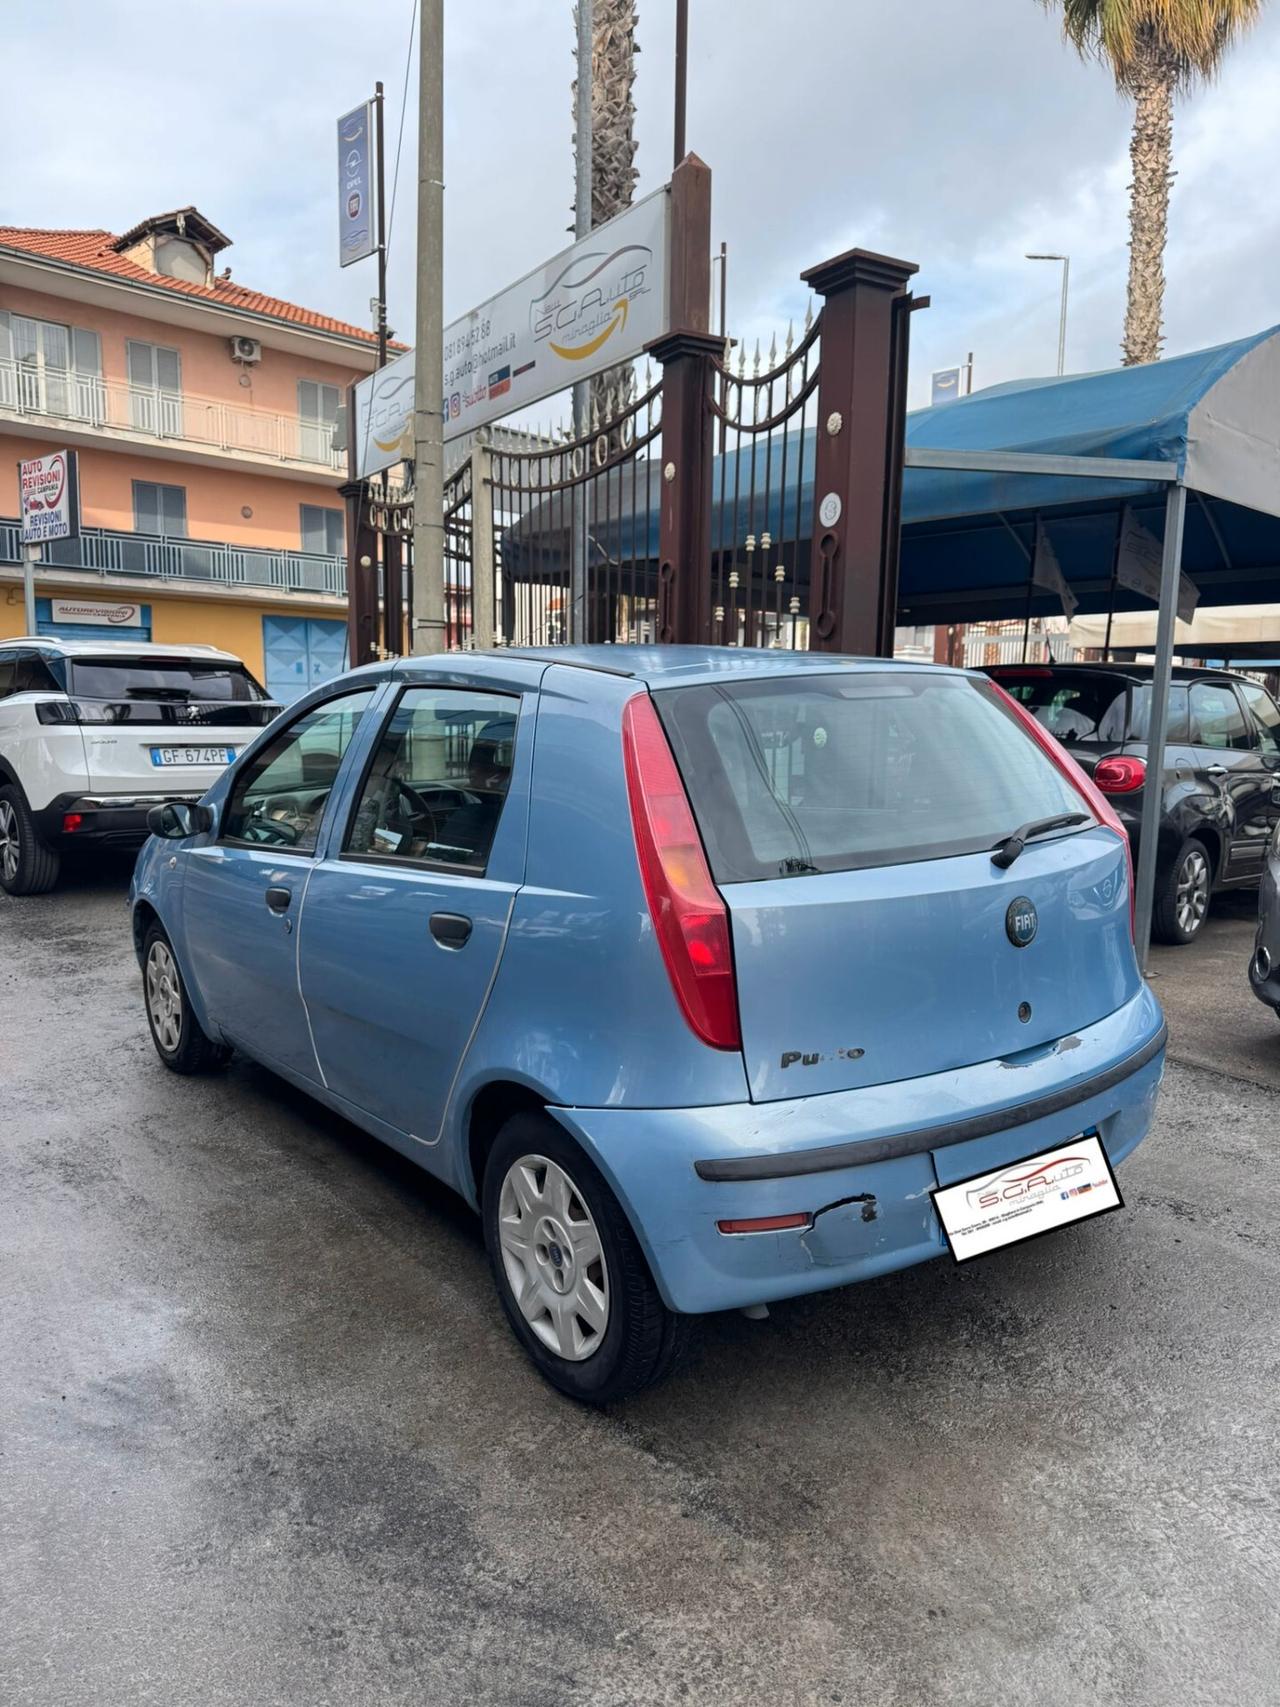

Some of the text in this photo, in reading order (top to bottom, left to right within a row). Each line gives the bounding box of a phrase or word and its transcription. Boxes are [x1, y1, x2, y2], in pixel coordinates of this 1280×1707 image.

[22, 461, 42, 475] AUTO
[23, 470, 61, 490] REVISIONI
[30, 510, 62, 527] REVISIONI
[25, 522, 68, 541] AUTO E MOTO
[162, 749, 226, 763] GF 674PF
[1015, 912, 1036, 932] FIAT
